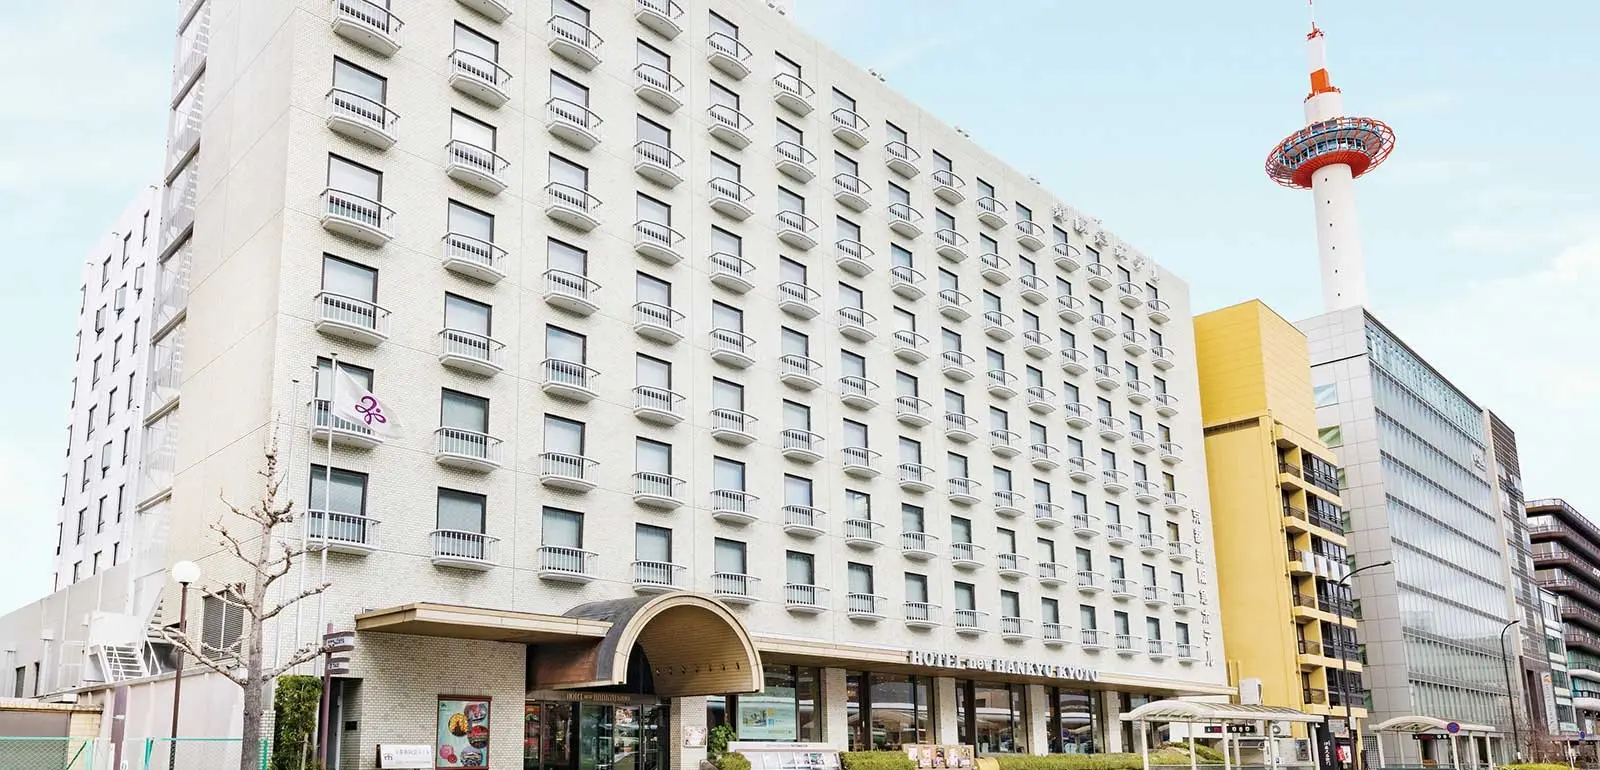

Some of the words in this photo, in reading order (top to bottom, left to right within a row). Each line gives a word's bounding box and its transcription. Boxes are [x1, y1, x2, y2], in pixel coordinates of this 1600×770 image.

[908, 650, 966, 669] HOTEL
[967, 657, 992, 671] new
[993, 657, 1053, 677] HANKYU
[1056, 666, 1099, 682] KYOTO
